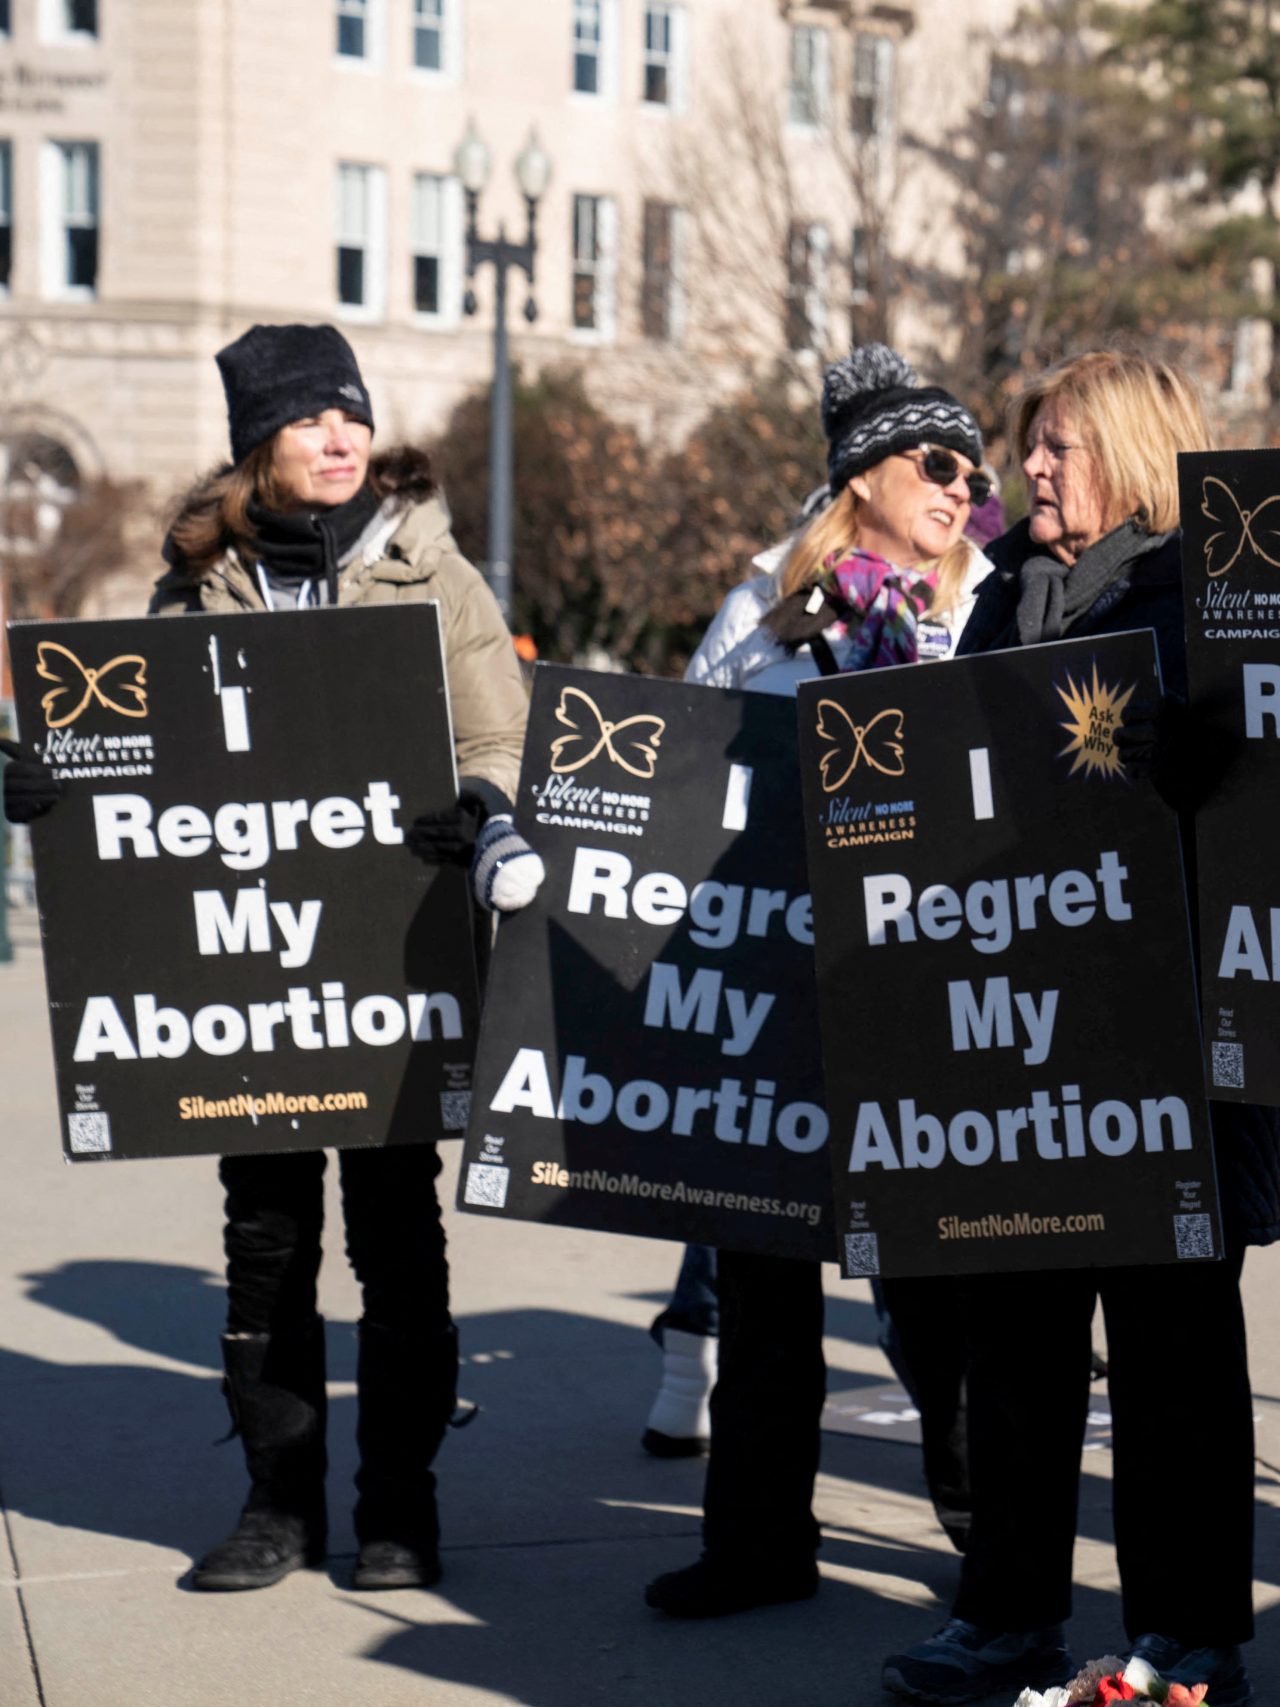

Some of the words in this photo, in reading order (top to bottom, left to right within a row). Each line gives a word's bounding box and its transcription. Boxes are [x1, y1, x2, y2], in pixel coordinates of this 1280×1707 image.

[1196, 580, 1251, 609] Silent
[1254, 593, 1268, 605] NO
[220, 686, 251, 752] I
[1089, 706, 1114, 724] Ask
[1089, 721, 1110, 737] Me
[34, 728, 101, 754] Silent
[103, 736, 121, 749] NO
[42, 748, 154, 764] AWARENESS
[1084, 734, 1114, 757] Why
[532, 773, 600, 804] Silent
[602, 791, 620, 805] NO
[722, 763, 752, 832] I
[969, 747, 995, 821] I
[536, 797, 649, 821] AWARENESS
[536, 812, 644, 836] CAMPAIGN
[819, 796, 872, 824] Silent
[875, 803, 888, 815] NO
[92, 781, 405, 870] Regret
[825, 816, 916, 836] AWARENESS
[827, 830, 914, 848] CAMPAIGN
[566, 846, 815, 949] Regre
[863, 851, 1132, 954] Regret
[193, 886, 323, 968] My
[73, 982, 463, 1062] Abortion
[643, 961, 775, 1056] My
[948, 976, 1059, 1066] My
[179, 1091, 368, 1120] SilentNoMore.com
[490, 1047, 829, 1154] Abortio
[848, 1084, 1193, 1173] Abortion
[531, 1160, 821, 1225] SilentNoMoreAwareness.org
[938, 1212, 1105, 1240] SilentNoMore.com
